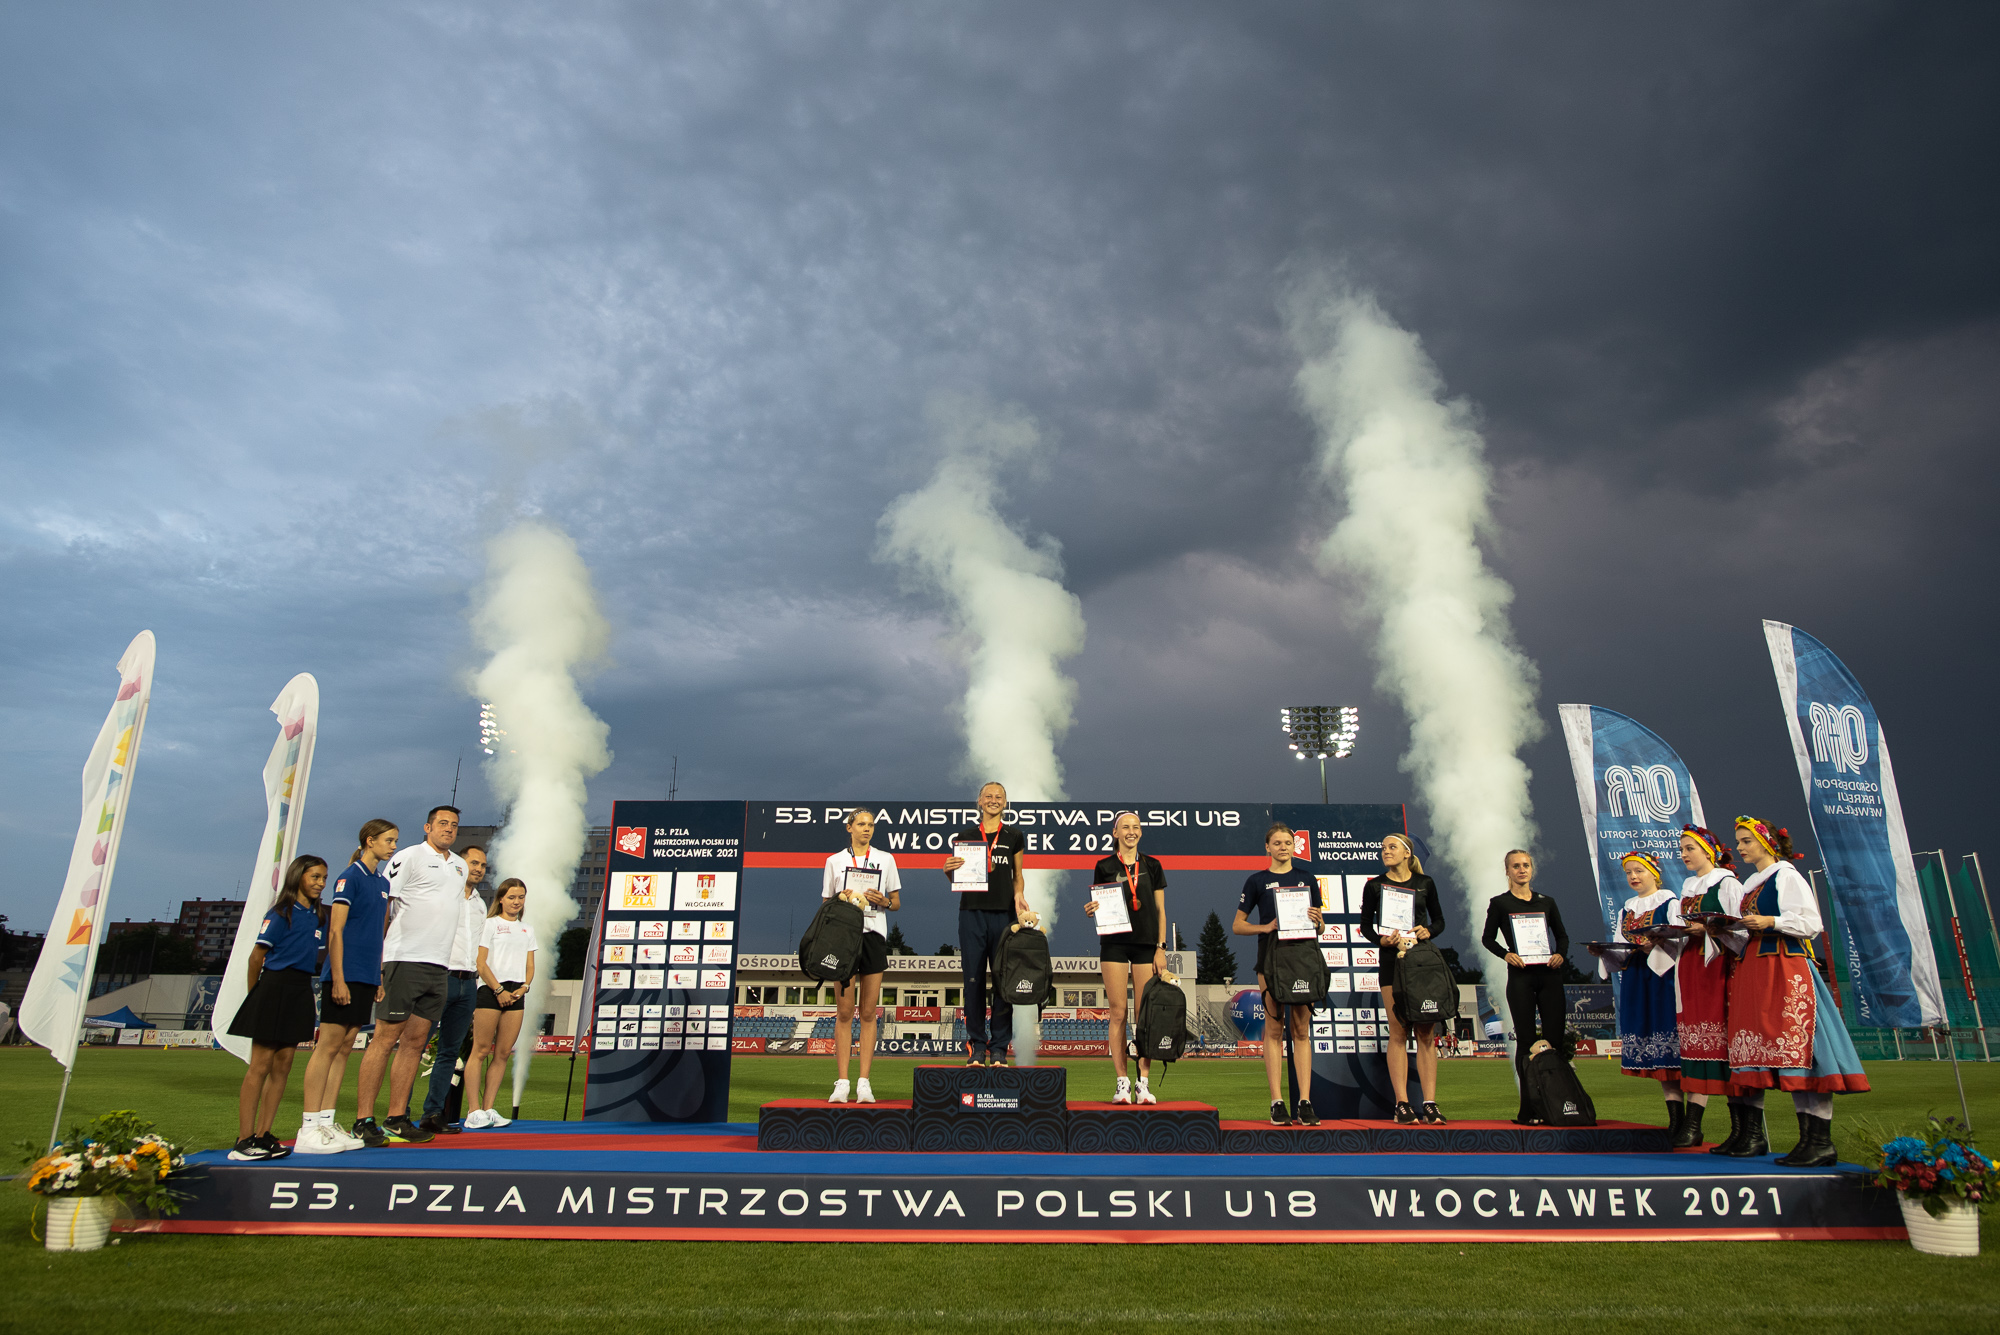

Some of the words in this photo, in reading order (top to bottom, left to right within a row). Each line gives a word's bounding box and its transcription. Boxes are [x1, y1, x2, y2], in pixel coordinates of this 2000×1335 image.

[775, 807, 816, 824] 53.
[825, 807, 893, 824] PZA
[900, 808, 1091, 826] MISTROSTWA
[1195, 810, 1241, 827] U18
[654, 828, 667, 836] 53.
[669, 828, 690, 836] PZLA
[1317, 831, 1330, 839] 53.
[1332, 831, 1352, 839] PZLA
[1069, 833, 1114, 851] 202
[1318, 841, 1364, 849] MISTRZOSTWA
[653, 849, 713, 858] WŁOCŁAWEK
[716, 849, 738, 858] 2021
[1318, 851, 1379, 861] WŁOCŁAWEK
[991, 855, 1009, 865] NTA
[625, 896, 654, 906] PZLA
[740, 955, 800, 968] OŚRODE
[888, 959, 963, 970] REKREACJ
[903, 1009, 933, 1018] PZLA
[1316, 1027, 1329, 1035] 4F
[559, 1040, 589, 1048] PZA
[768, 1040, 783, 1050] 4F
[789, 1041, 805, 1050] 4F
[1044, 1044, 1072, 1052] LEKKIEJ
[269, 1182, 356, 1210] 53.
[388, 1184, 526, 1213] PZLA
[557, 1185, 966, 1217] MISTRZOSTWA
[996, 1189, 1192, 1218] POLSKI
[1225, 1189, 1318, 1218] U18
[1368, 1187, 1657, 1218] WŁOCŁAWEK
[1683, 1186, 1783, 1216] 2021
